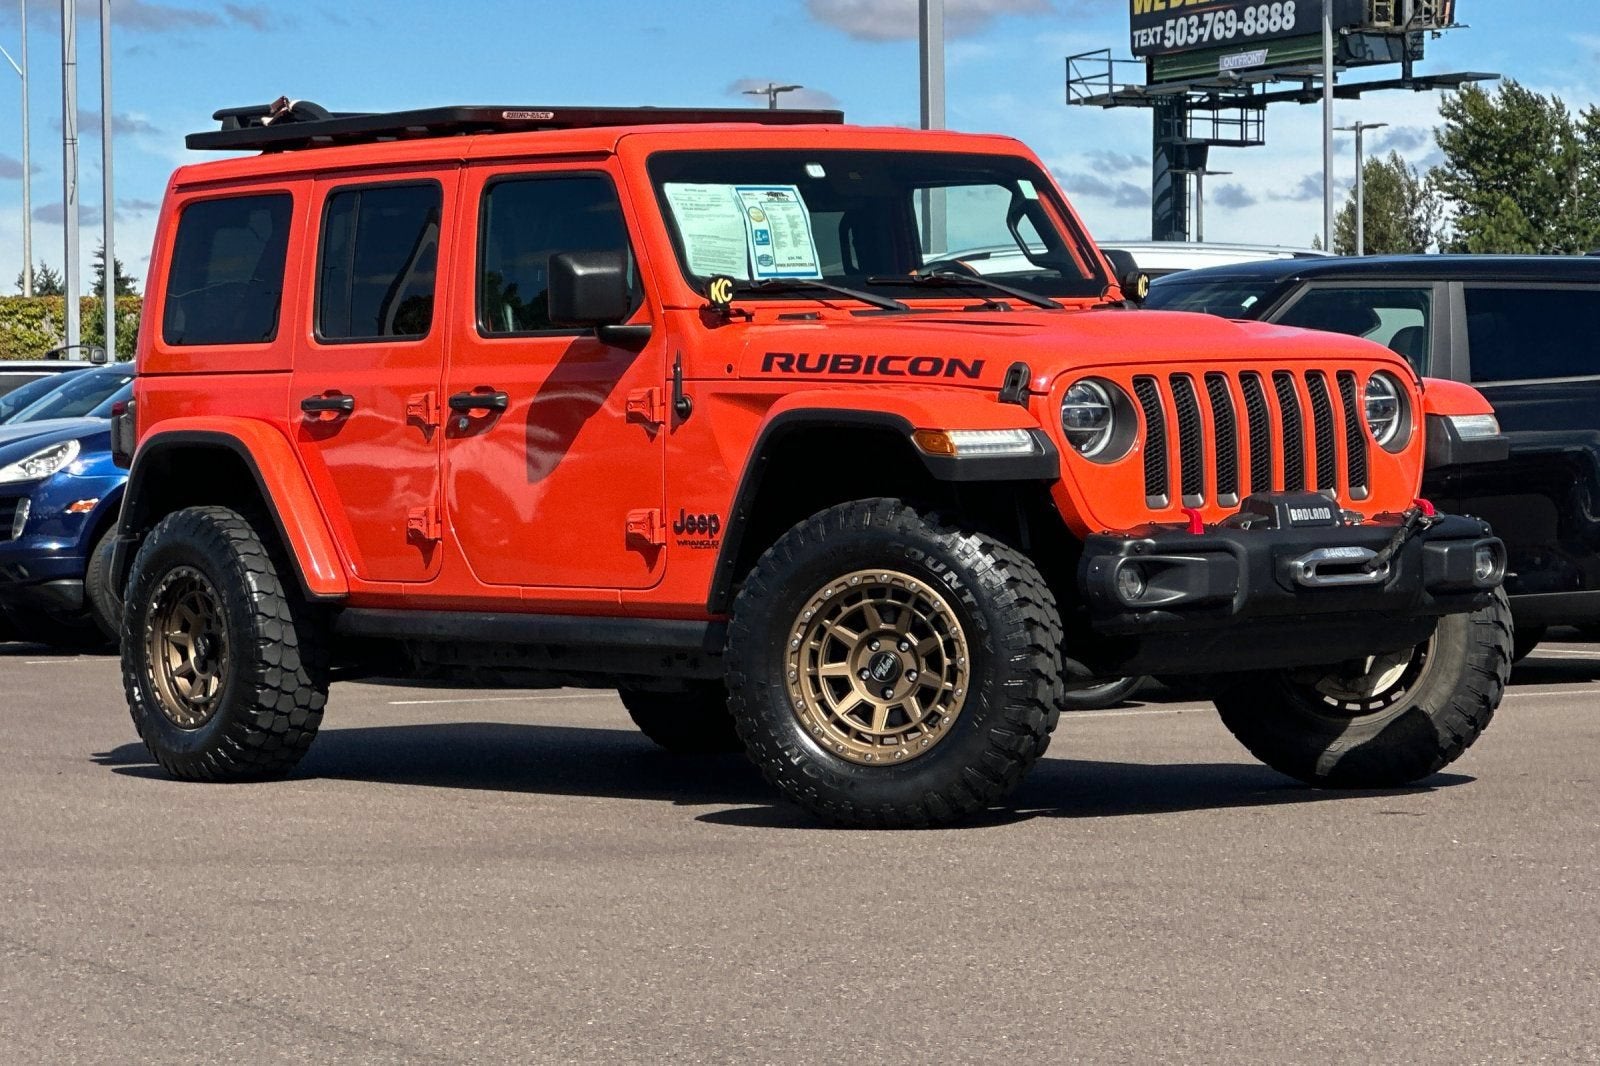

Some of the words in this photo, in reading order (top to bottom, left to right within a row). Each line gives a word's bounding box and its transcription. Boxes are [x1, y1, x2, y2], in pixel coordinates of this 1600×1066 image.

[1133, 26, 1163, 48] TEXT
[1164, 0, 1296, 49] 503-769-8888
[1223, 52, 1263, 67] OUTFRONT
[711, 278, 733, 303] KC
[1138, 274, 1148, 298] KC
[761, 352, 986, 379] RUBICON
[673, 508, 721, 539] Jeep
[1290, 507, 1331, 521] BADLAND
